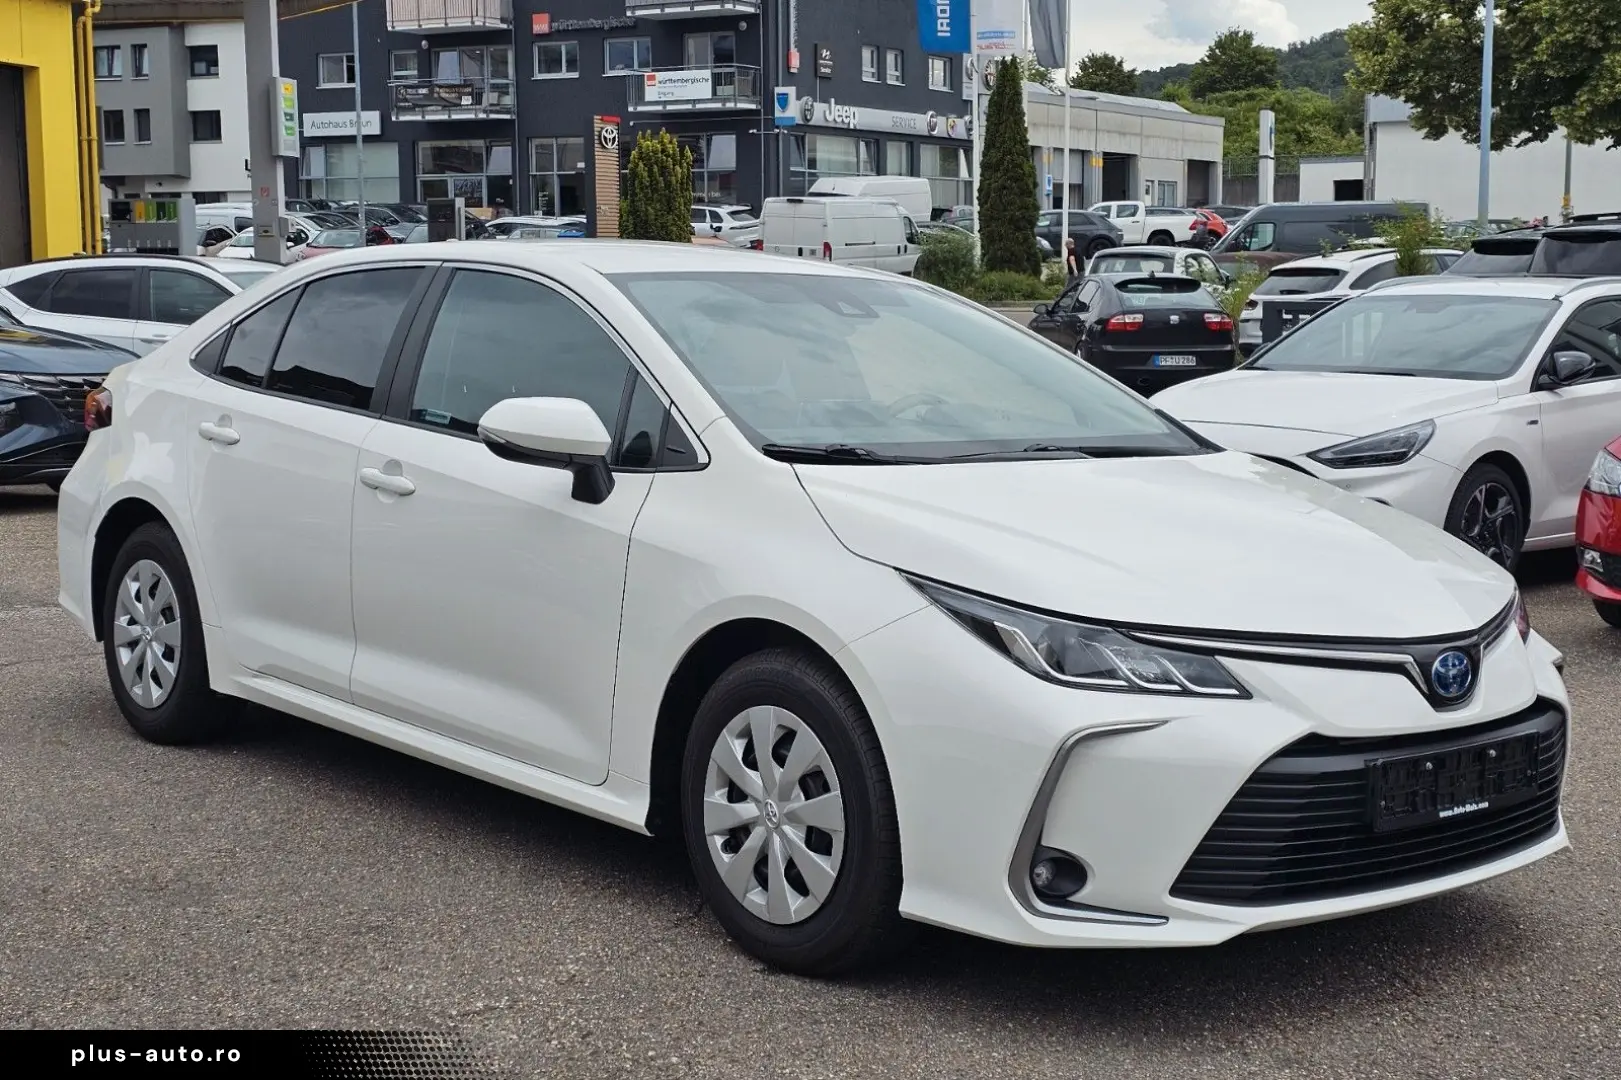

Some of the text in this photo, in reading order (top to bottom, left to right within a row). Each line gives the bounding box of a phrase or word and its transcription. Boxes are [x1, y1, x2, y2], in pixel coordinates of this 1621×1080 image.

[310, 119, 372, 130] Autohaus Brun
[823, 97, 917, 130] Jeep SERVICE
